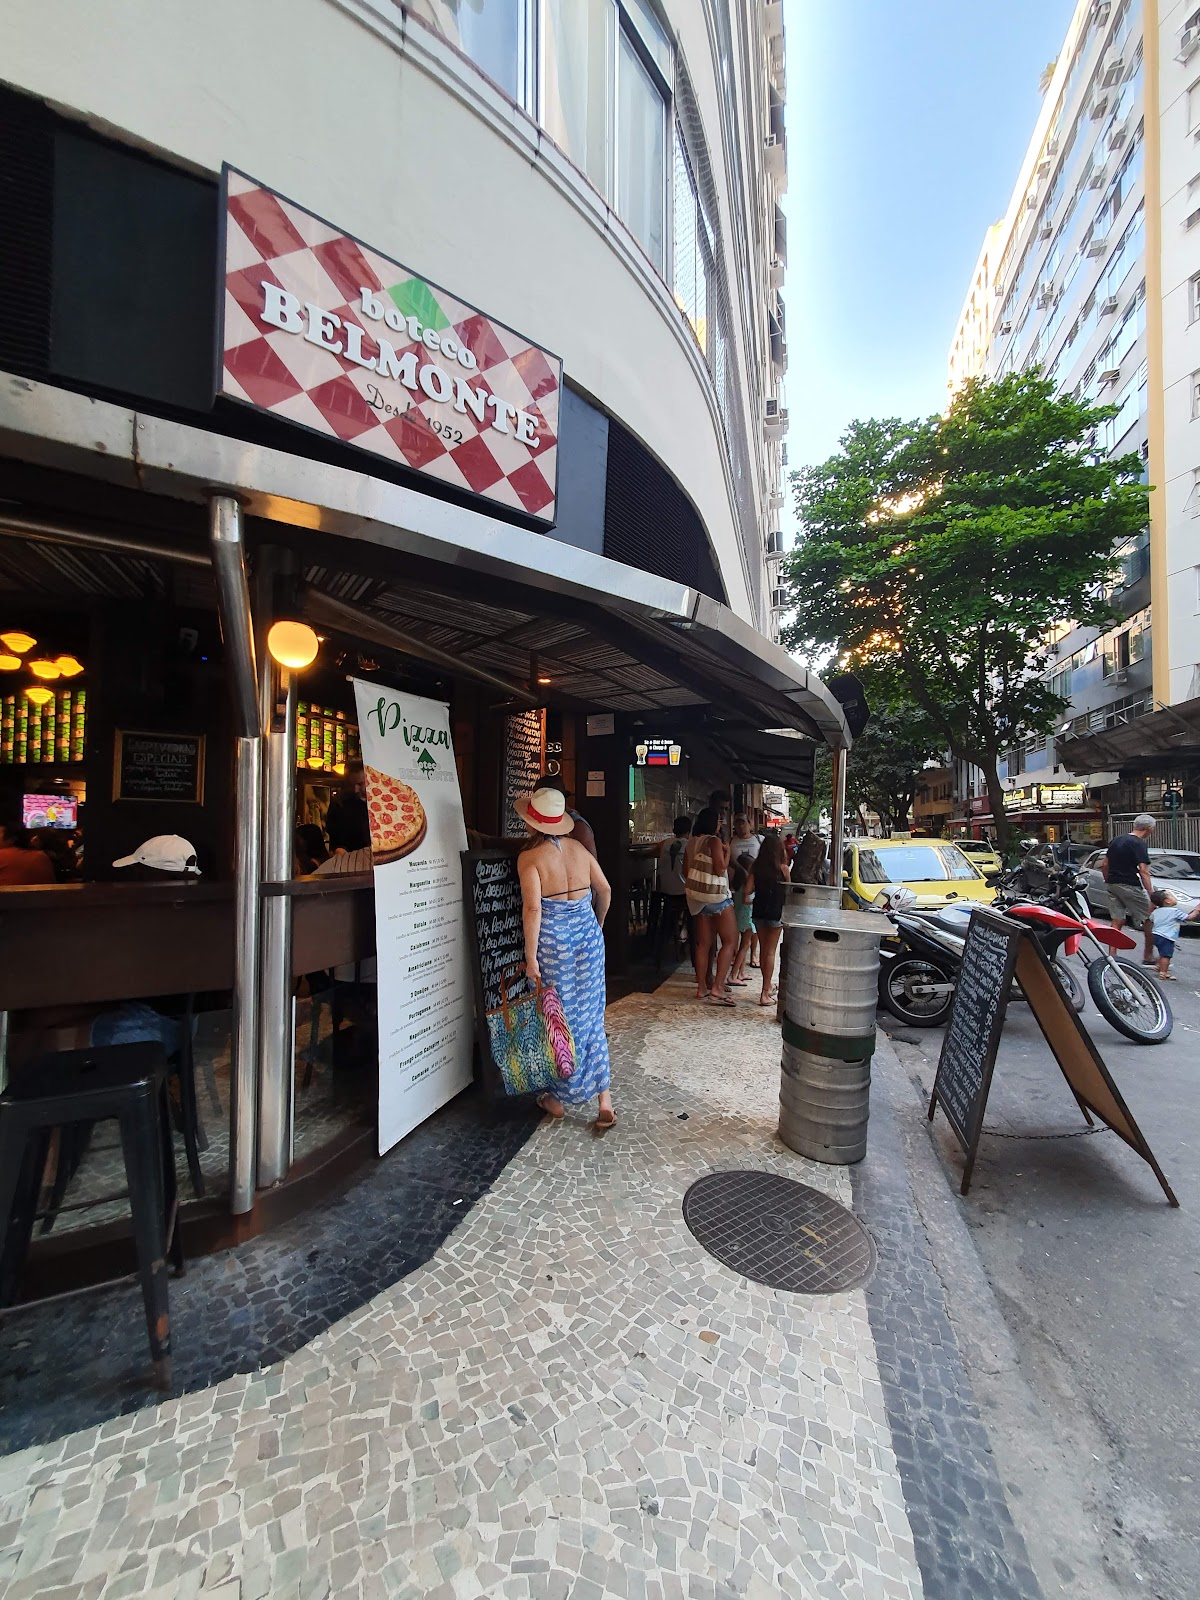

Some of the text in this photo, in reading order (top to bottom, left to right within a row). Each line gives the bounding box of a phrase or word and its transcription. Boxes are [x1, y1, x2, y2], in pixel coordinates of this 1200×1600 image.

[360, 286, 477, 369] boteco
[260, 280, 540, 449] BELMONTE
[365, 383, 463, 445] Desde 1952
[367, 697, 450, 750] Pizza
